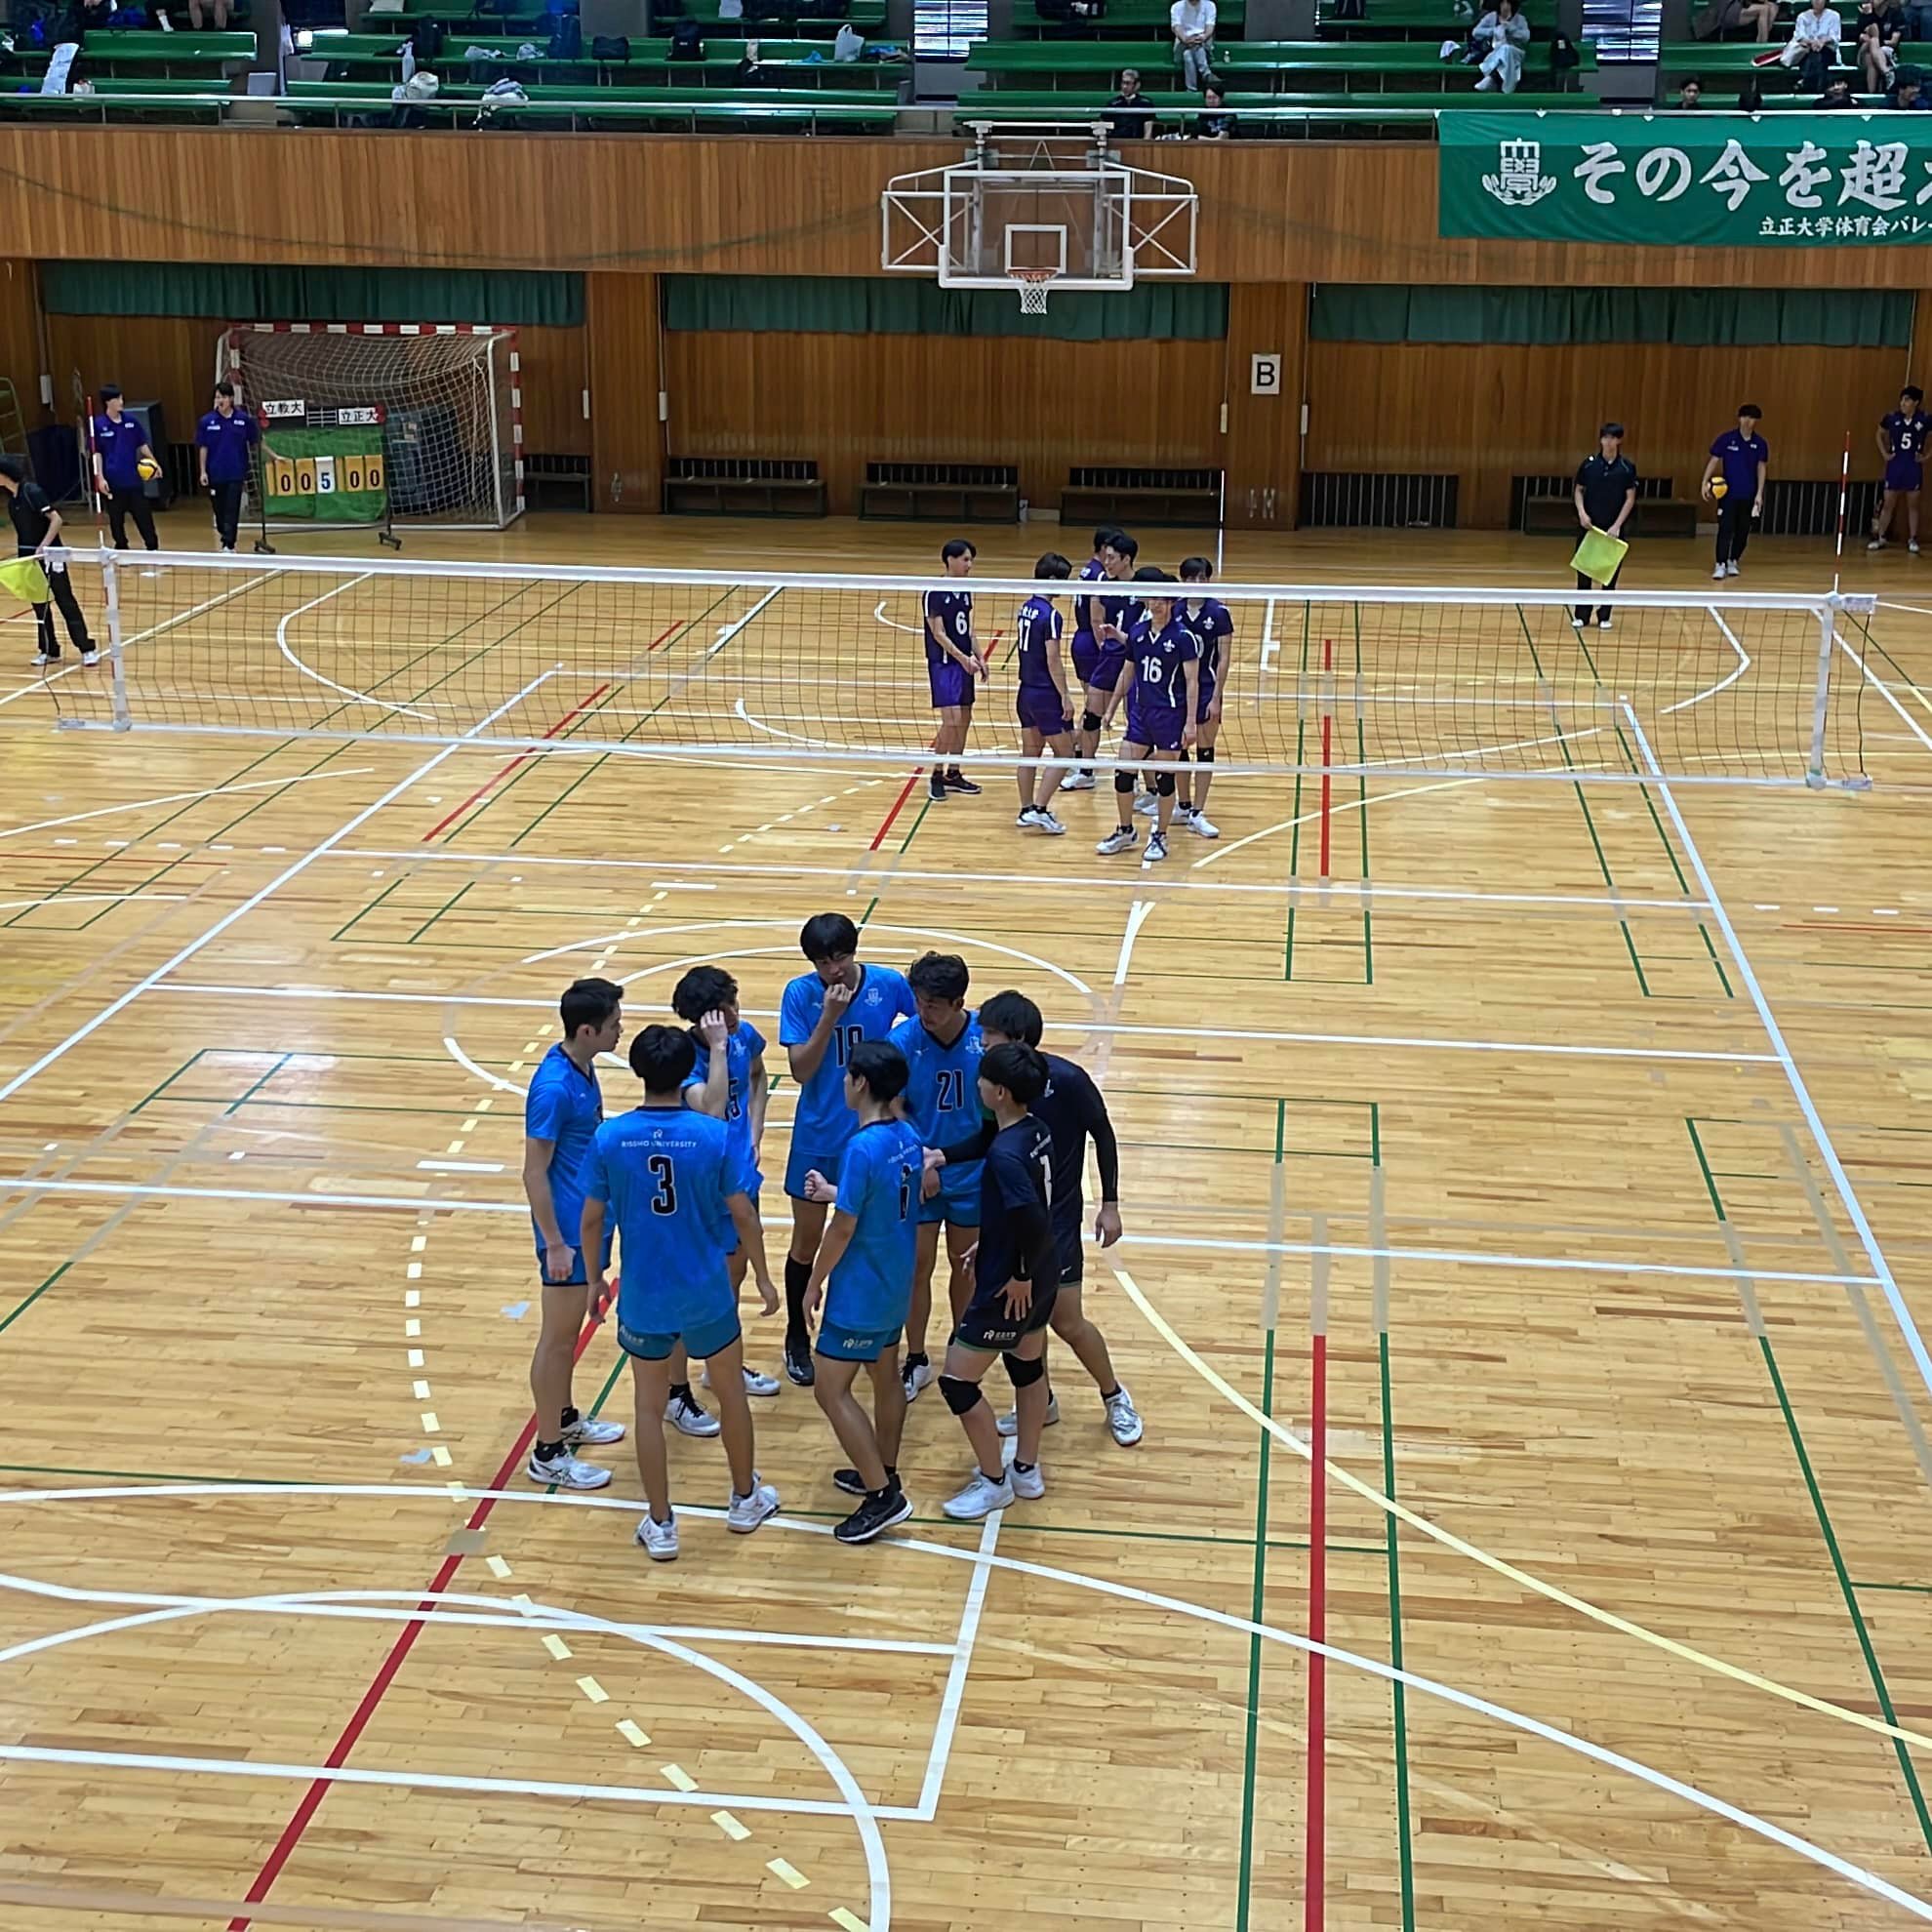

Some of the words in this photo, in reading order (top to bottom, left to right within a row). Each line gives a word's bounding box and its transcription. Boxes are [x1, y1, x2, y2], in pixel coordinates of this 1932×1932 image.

[1256, 361, 1275, 386] B
[342, 411, 378, 423] 立正大
[1900, 432, 1912, 450] 5
[320, 472, 331, 490] 5
[955, 611, 968, 635] 6
[1141, 655, 1162, 683] 16
[936, 1068, 964, 1112] 21
[647, 1153, 677, 1217] 3
